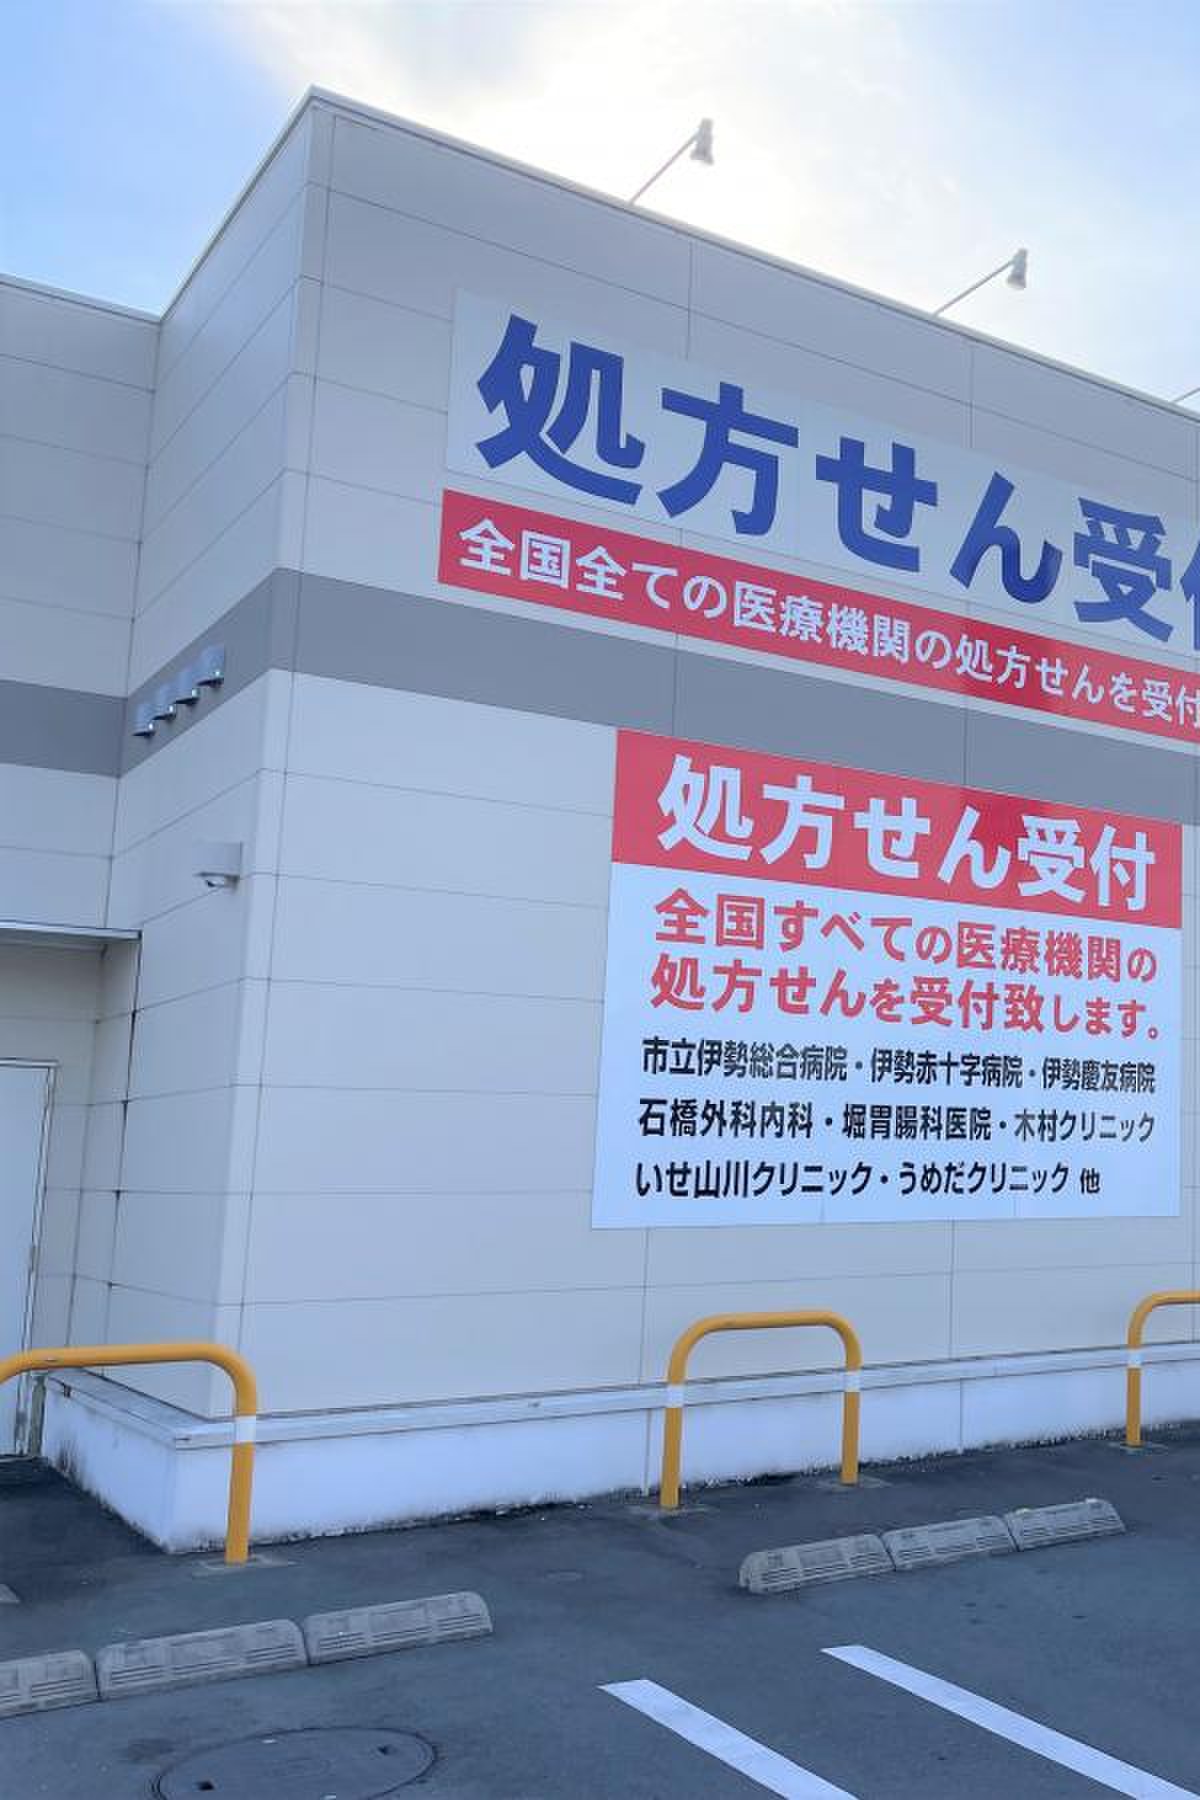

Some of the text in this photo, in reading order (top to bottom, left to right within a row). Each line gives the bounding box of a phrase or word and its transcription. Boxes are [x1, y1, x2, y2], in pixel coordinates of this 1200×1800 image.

[657, 753, 1156, 912] 処方せん受付
[654, 886, 1158, 984] 全国すべての医療機関の
[650, 952, 1159, 1040] 処方せんを受付致します。
[1080, 1167, 1101, 1195] 他
